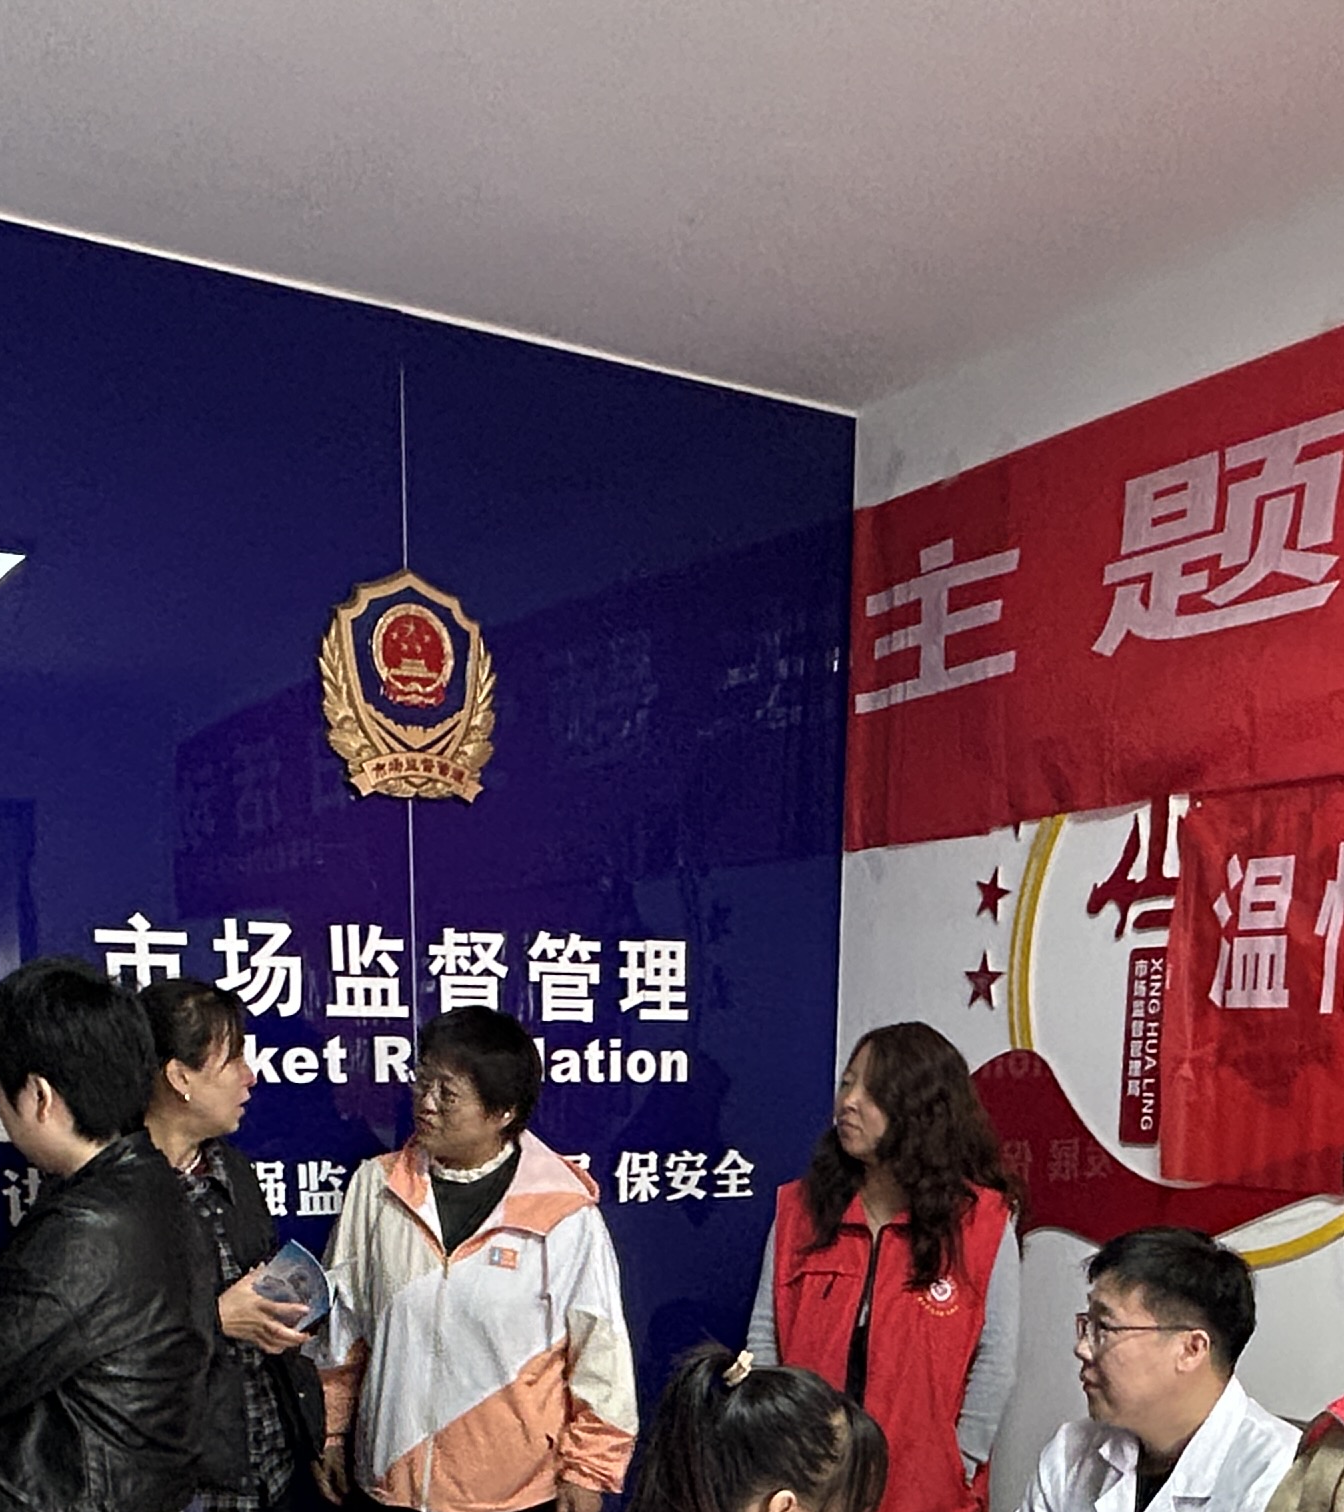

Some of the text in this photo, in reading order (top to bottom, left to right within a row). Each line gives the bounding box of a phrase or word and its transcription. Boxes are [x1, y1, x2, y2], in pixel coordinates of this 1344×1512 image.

[94, 912, 690, 1024] 市场监督管理
[243, 1034, 349, 1084] ket
[1140, 958, 1164, 1131] XING HUA LING
[614, 1149, 755, 1203] 保安全
